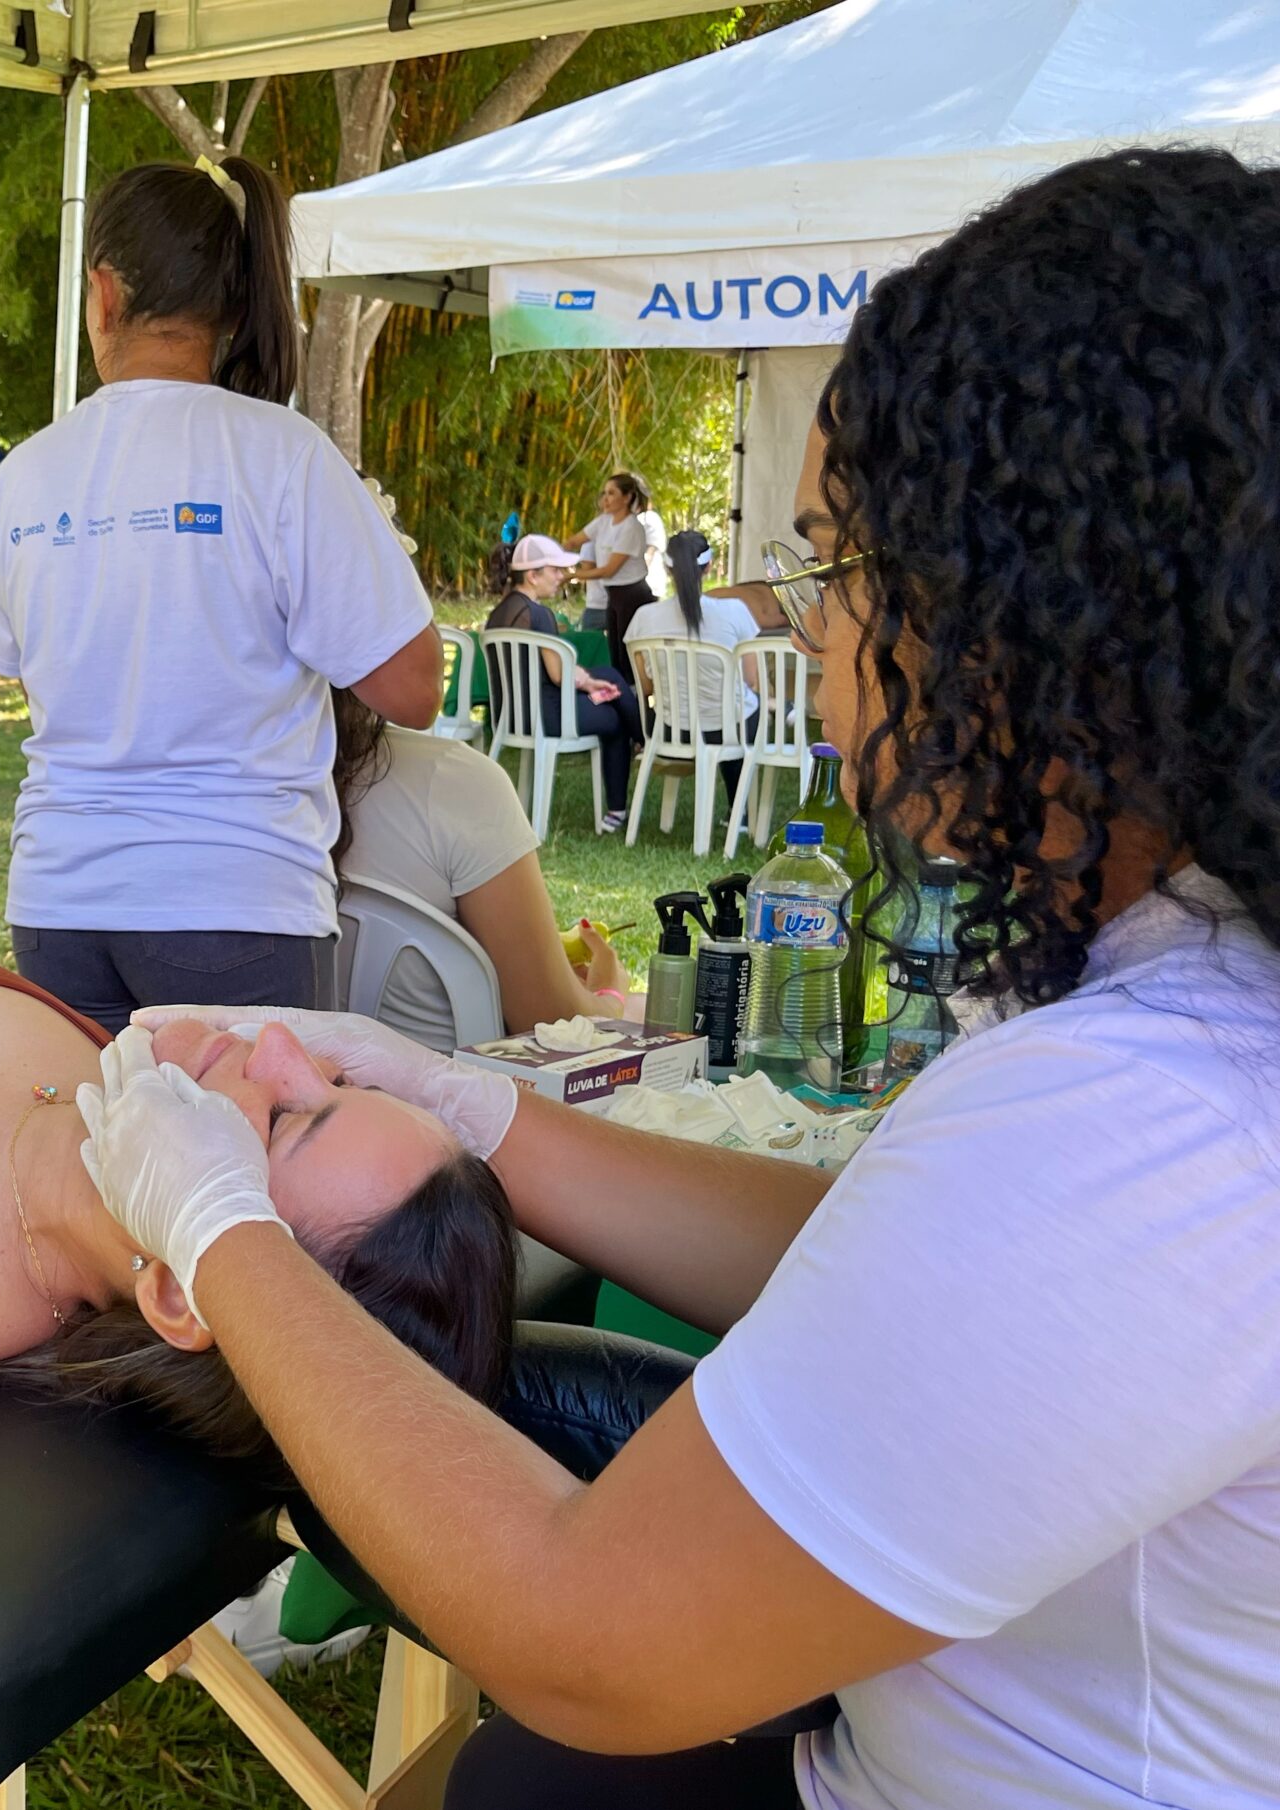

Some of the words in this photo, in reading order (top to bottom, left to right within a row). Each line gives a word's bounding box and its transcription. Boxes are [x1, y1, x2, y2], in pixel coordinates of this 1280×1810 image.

[196, 513, 219, 524] GDF
[512, 1074, 537, 1090] ÁTEX
[567, 1078, 594, 1095] LUVA
[594, 1074, 608, 1088] DE
[609, 1066, 638, 1084] LÁTEX
